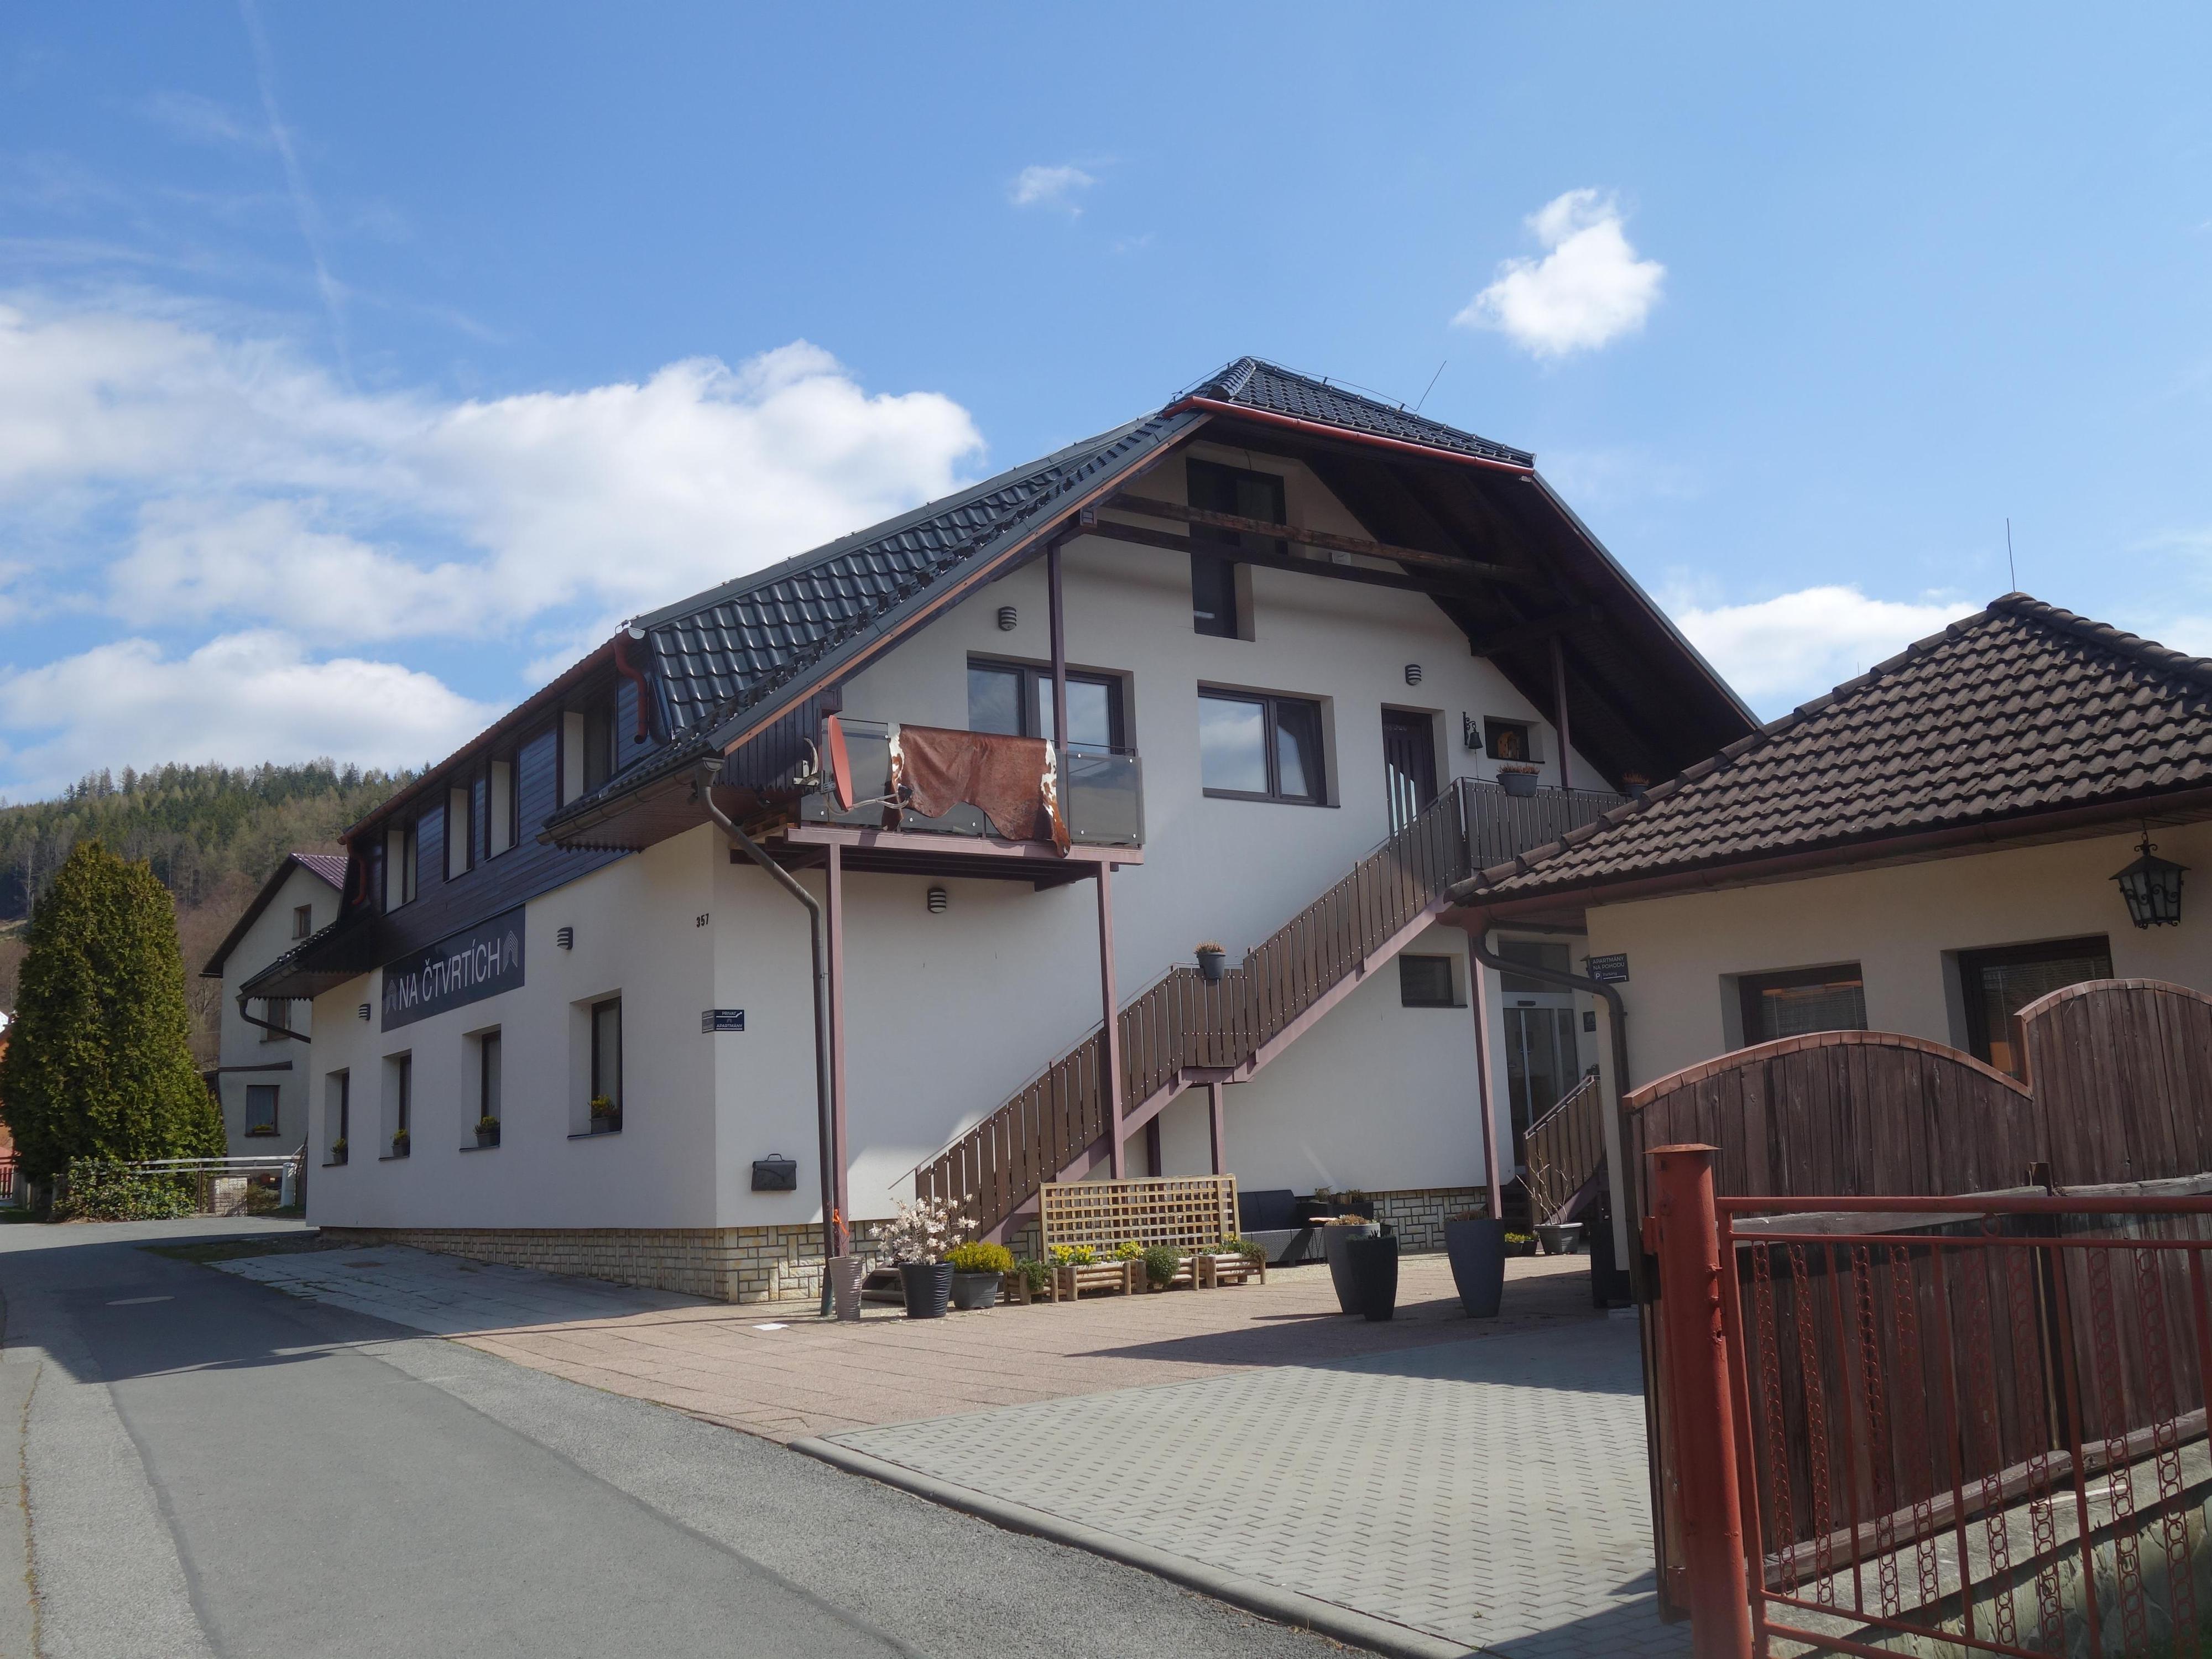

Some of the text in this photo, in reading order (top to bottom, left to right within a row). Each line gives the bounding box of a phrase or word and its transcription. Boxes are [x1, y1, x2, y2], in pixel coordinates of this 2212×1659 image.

[696, 913, 709, 928] 357
[399, 938, 500, 1010] NA ČTVRTÍCH
